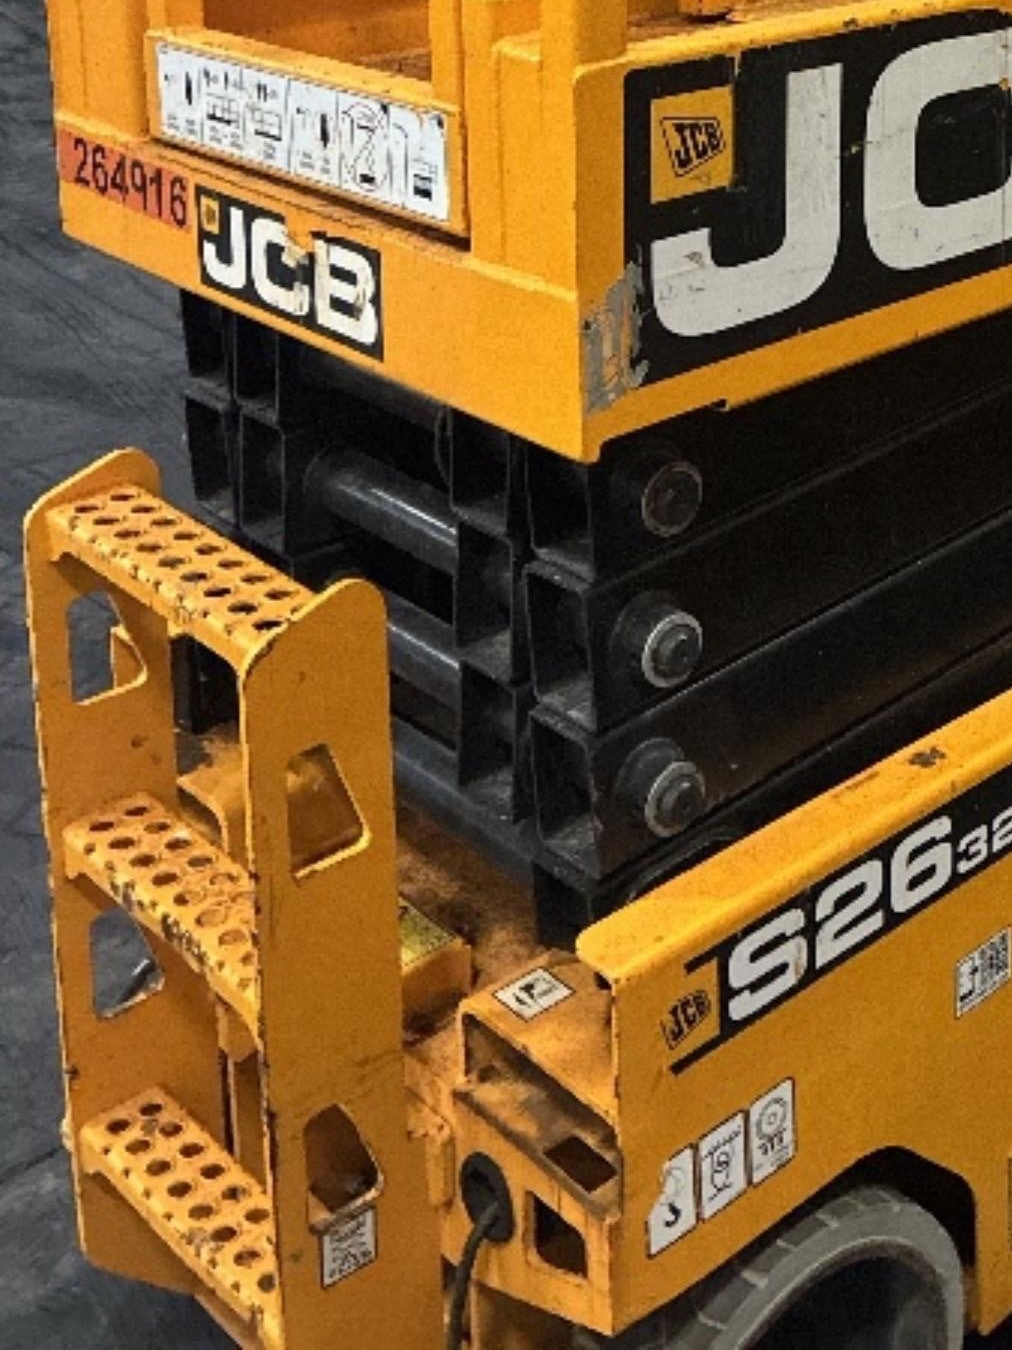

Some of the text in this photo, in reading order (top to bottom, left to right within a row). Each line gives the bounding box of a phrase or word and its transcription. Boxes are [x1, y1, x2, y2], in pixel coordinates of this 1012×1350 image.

[73, 137, 188, 228] 264916
[672, 122, 721, 169] JCB
[202, 205, 379, 345] JCB
